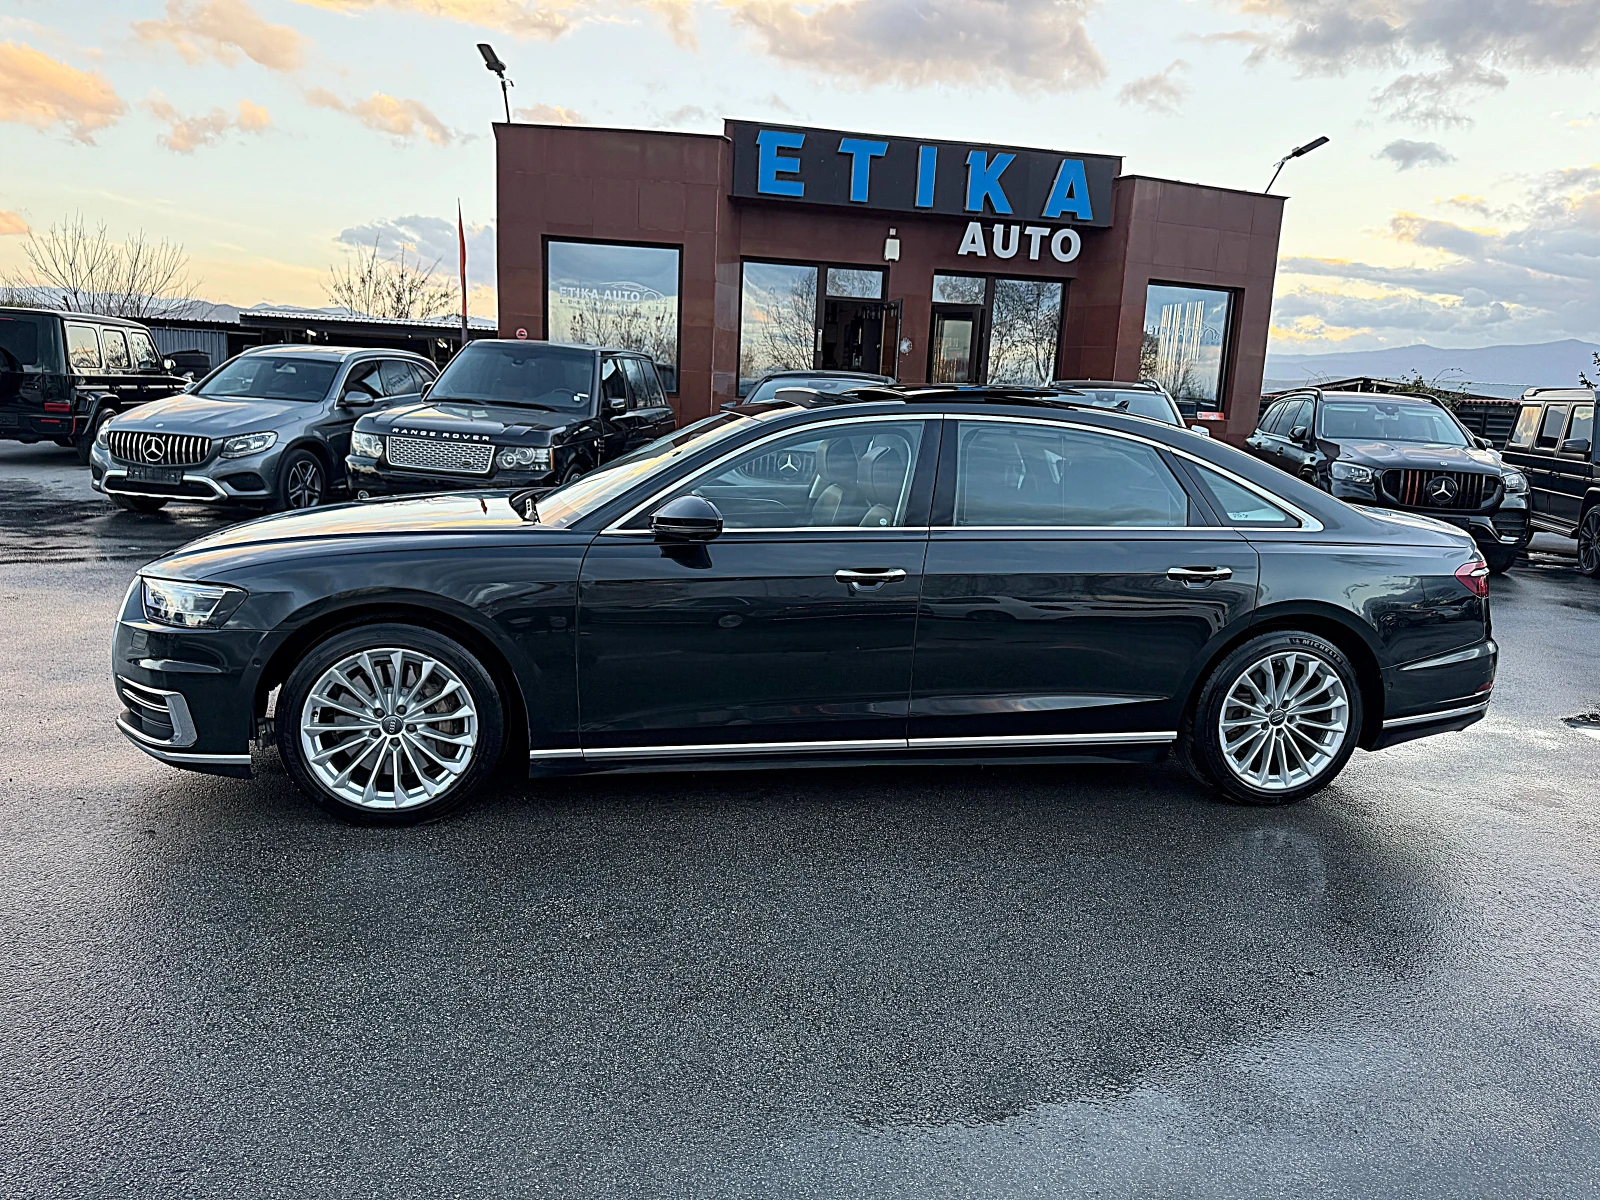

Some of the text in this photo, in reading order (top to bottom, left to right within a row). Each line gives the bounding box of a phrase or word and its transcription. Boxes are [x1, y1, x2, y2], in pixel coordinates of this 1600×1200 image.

[756, 130, 1093, 221] ETIKA
[957, 221, 1082, 263] AUTO
[559, 286, 640, 302] ETIKA AUTO
[392, 427, 490, 441] RANGE ROVER
[1302, 639, 1342, 662] MICHELIN
